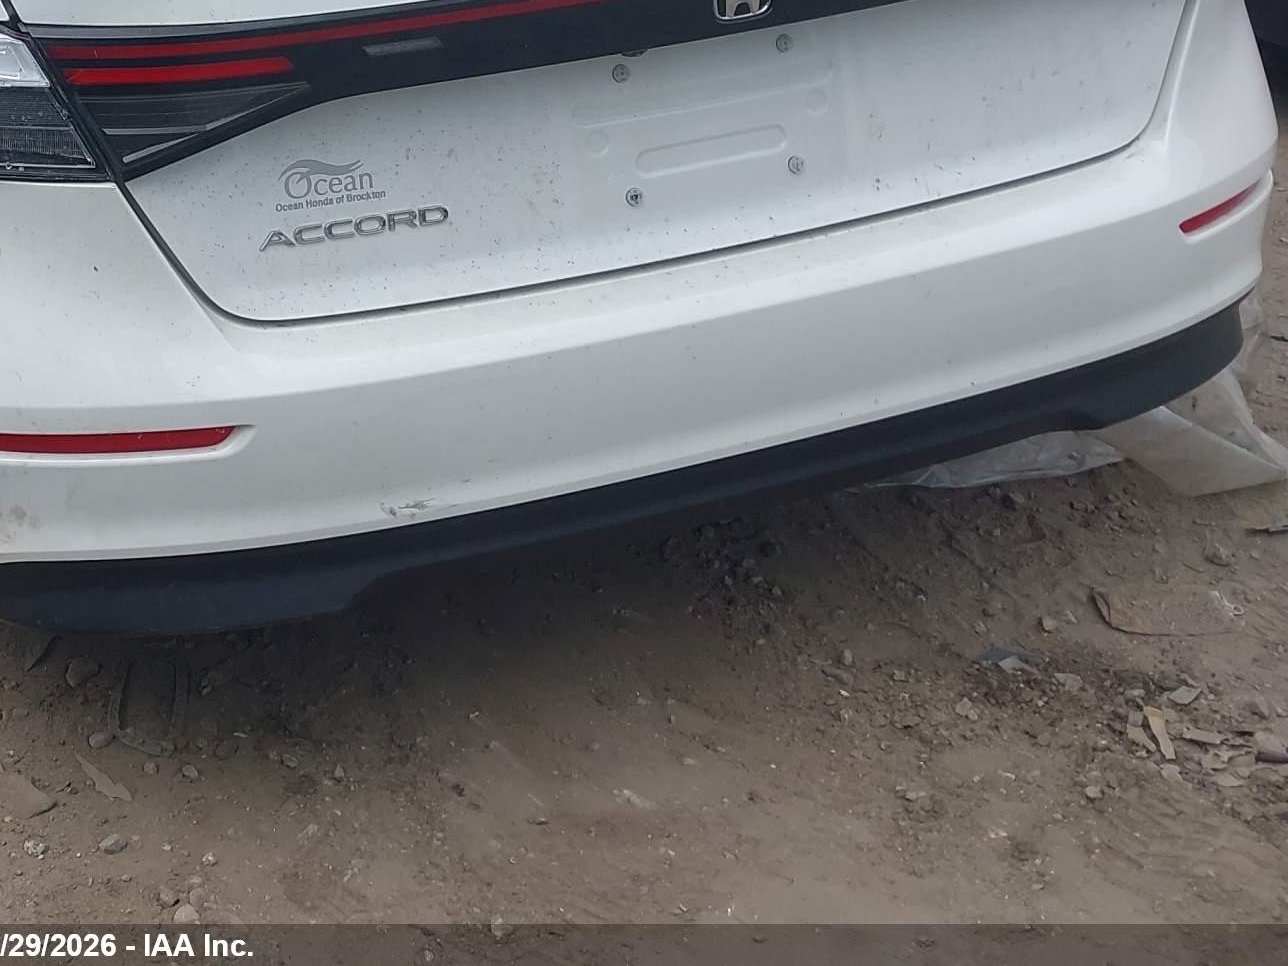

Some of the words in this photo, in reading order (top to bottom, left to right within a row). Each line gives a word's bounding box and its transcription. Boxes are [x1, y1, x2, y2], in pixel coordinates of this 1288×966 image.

[284, 171, 374, 199] Ocean
[275, 201, 304, 212] Ocean
[305, 196, 334, 209] Honda
[335, 194, 345, 204] of
[346, 190, 386, 202] Brockton
[259, 205, 450, 252] ACCORD
